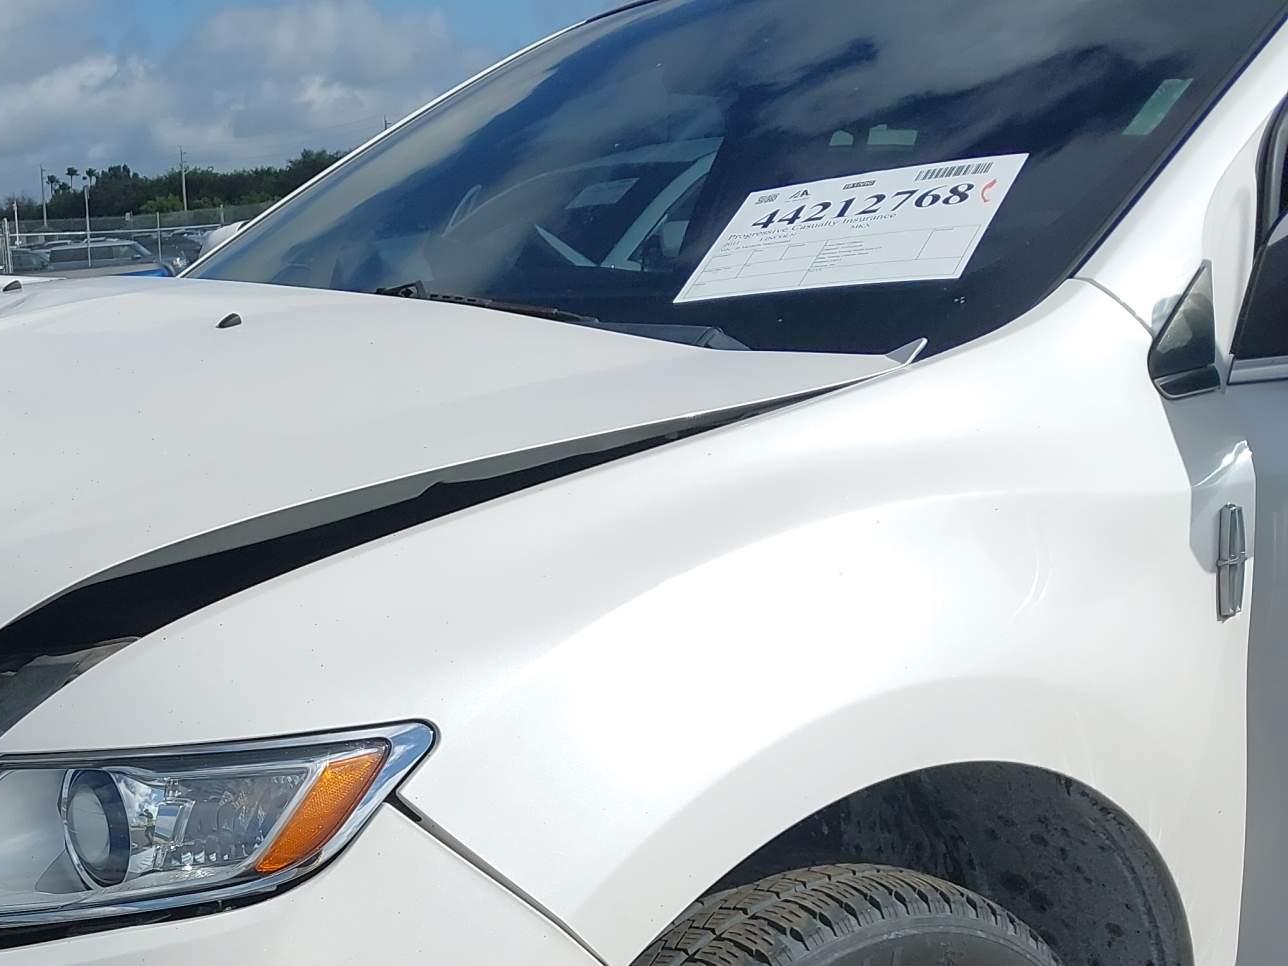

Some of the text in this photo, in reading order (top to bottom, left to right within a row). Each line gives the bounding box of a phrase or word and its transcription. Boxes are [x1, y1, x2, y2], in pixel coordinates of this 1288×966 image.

[751, 183, 975, 230] 44212768
[727, 212, 897, 241] Progressive Casualty Insurance
